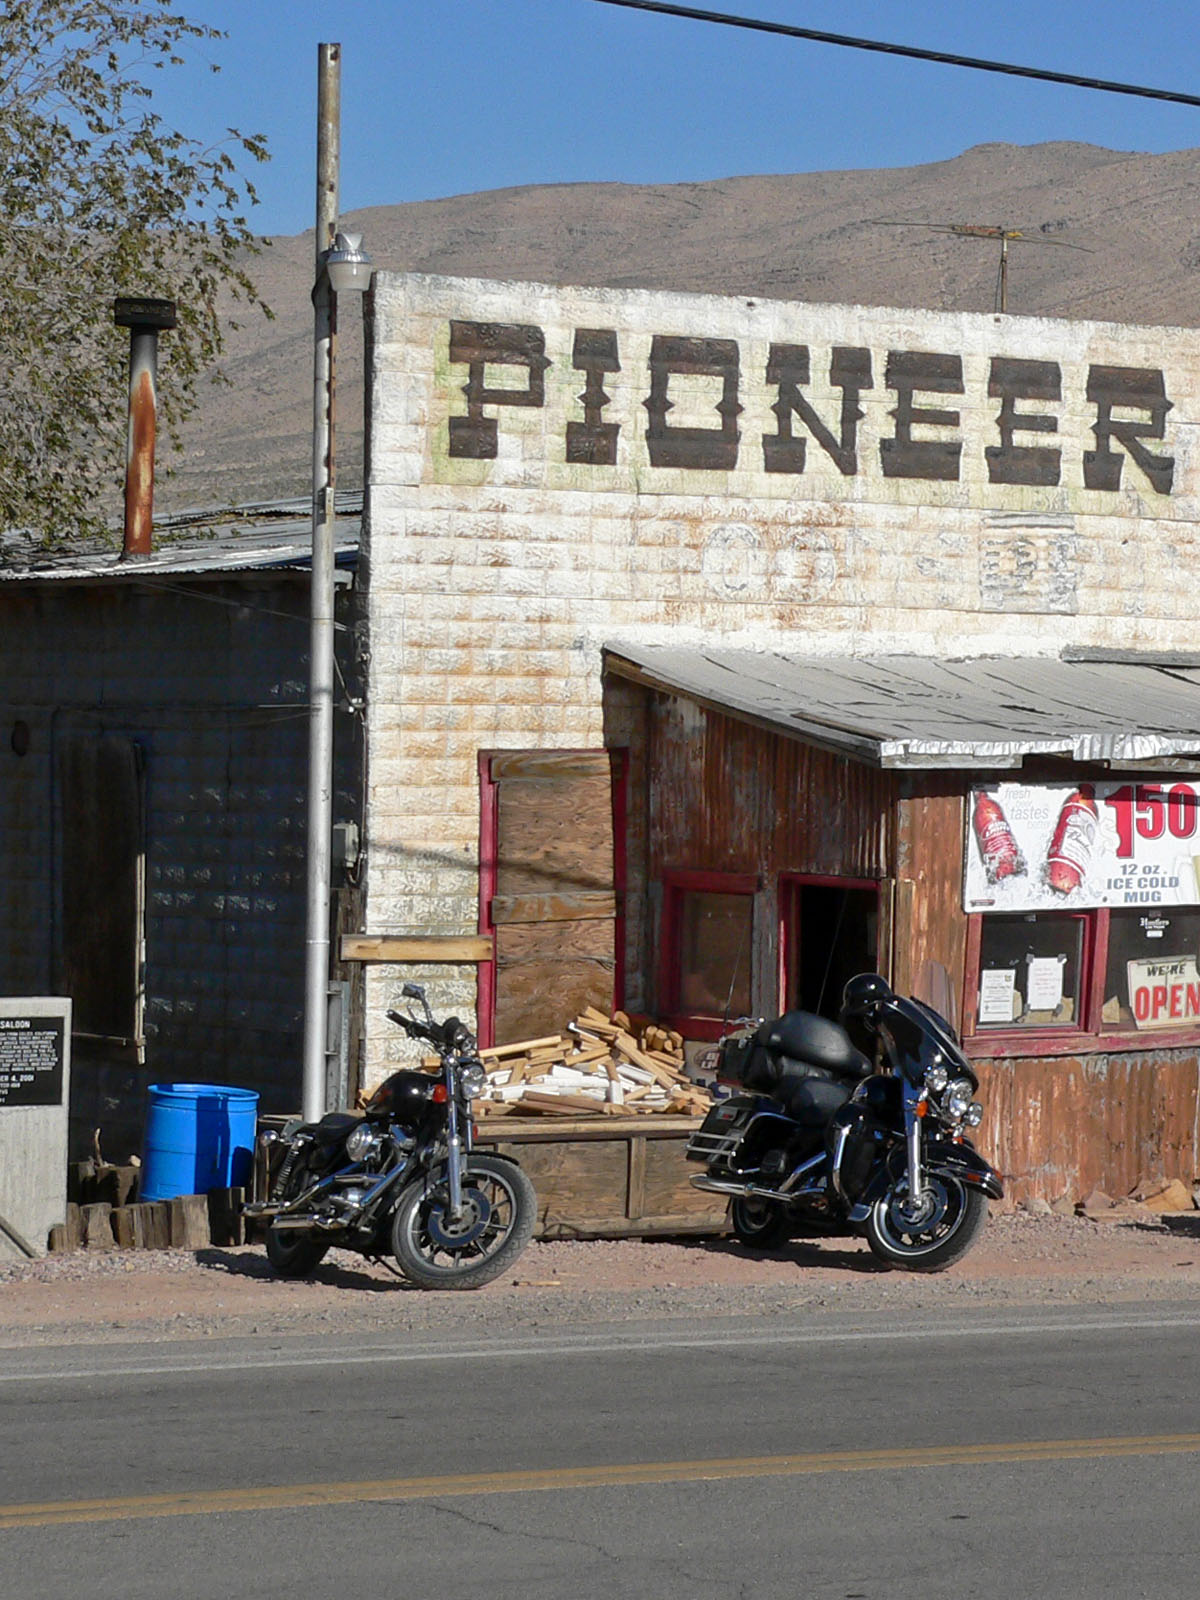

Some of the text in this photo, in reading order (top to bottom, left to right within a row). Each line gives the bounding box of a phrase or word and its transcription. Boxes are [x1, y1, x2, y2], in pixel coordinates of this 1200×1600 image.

[448, 319, 1176, 495] PIONEER
[1004, 788, 1031, 799] fresh
[1009, 806, 1049, 820] tastes
[1120, 864, 1137, 875] 12
[1107, 876, 1179, 889] ICE COLD
[1124, 891, 1161, 903] MUG
[1146, 963, 1187, 977] WE'RE
[0, 1020, 31, 1029] SALOON
